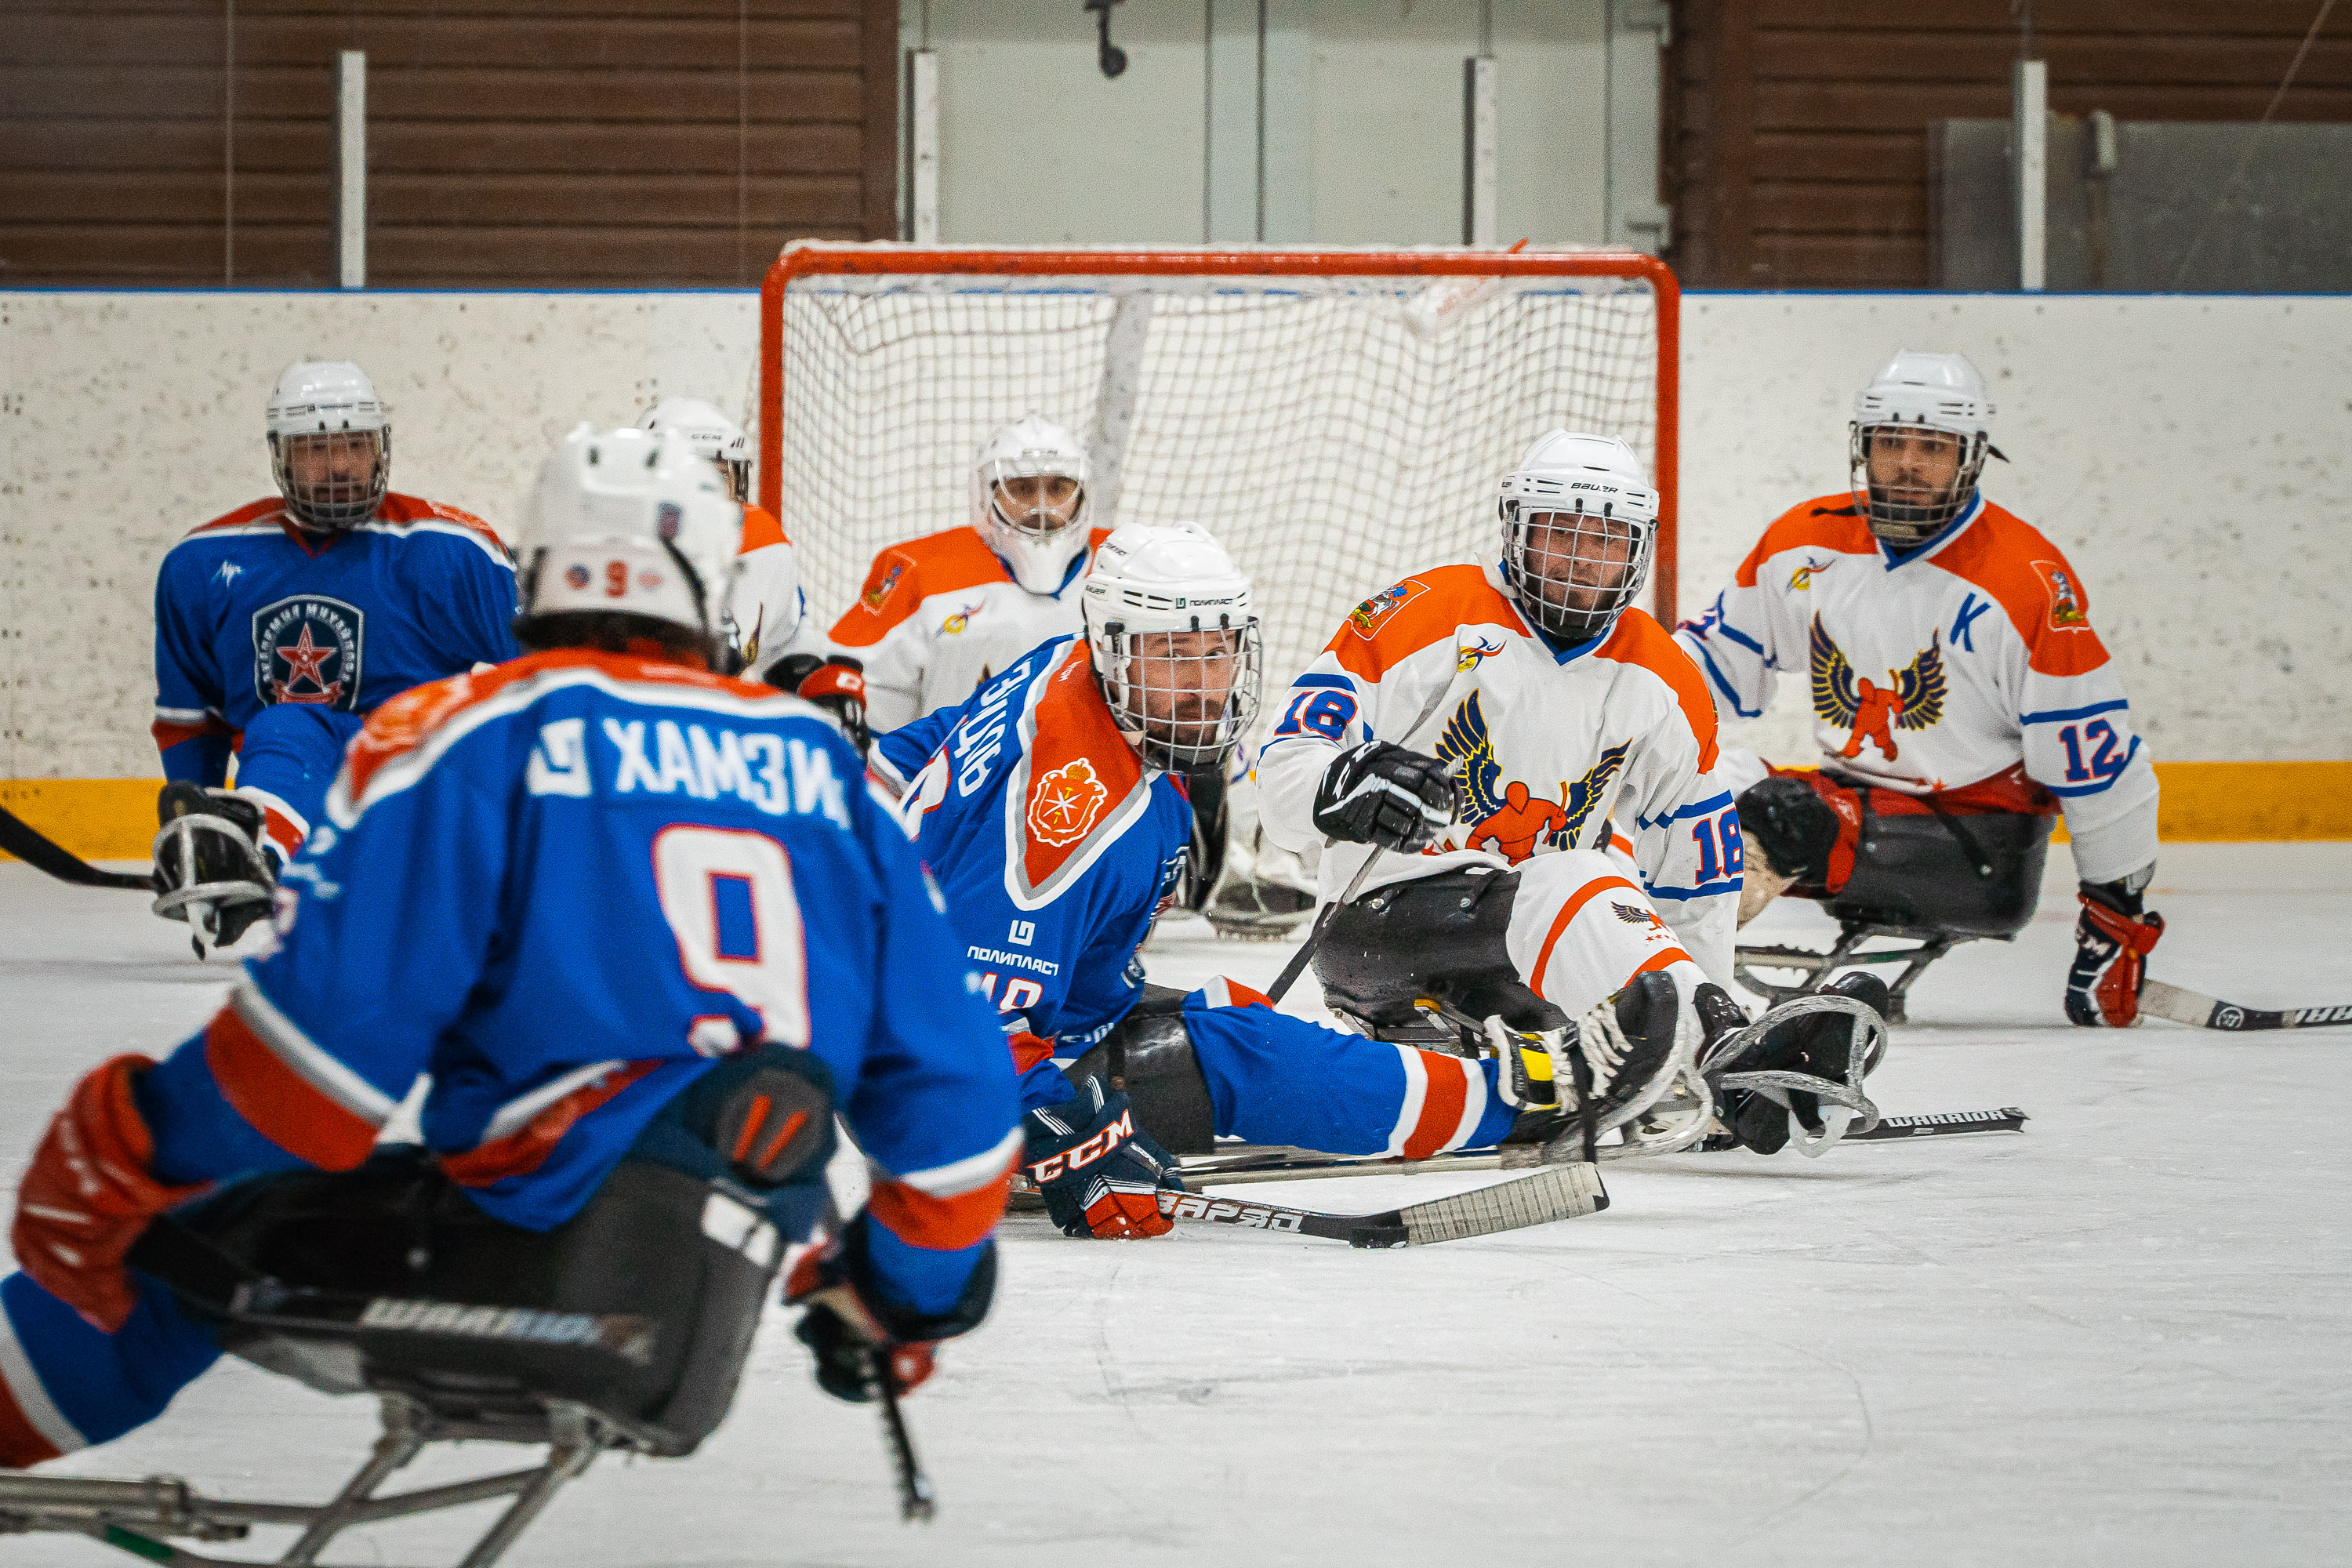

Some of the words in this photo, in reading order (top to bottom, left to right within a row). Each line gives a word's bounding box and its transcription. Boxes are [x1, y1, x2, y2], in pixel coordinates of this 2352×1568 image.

[1570, 482, 1618, 494] BAUER
[1274, 689, 1359, 742] 18
[2059, 718, 2125, 783] 12
[1692, 808, 1744, 885] 18
[652, 822, 811, 1058] 9
[966, 945, 1059, 977] ПОЛИПЛАСТ
[1027, 1108, 1134, 1184] CCM
[1886, 1109, 2008, 1127] WARRIOR
